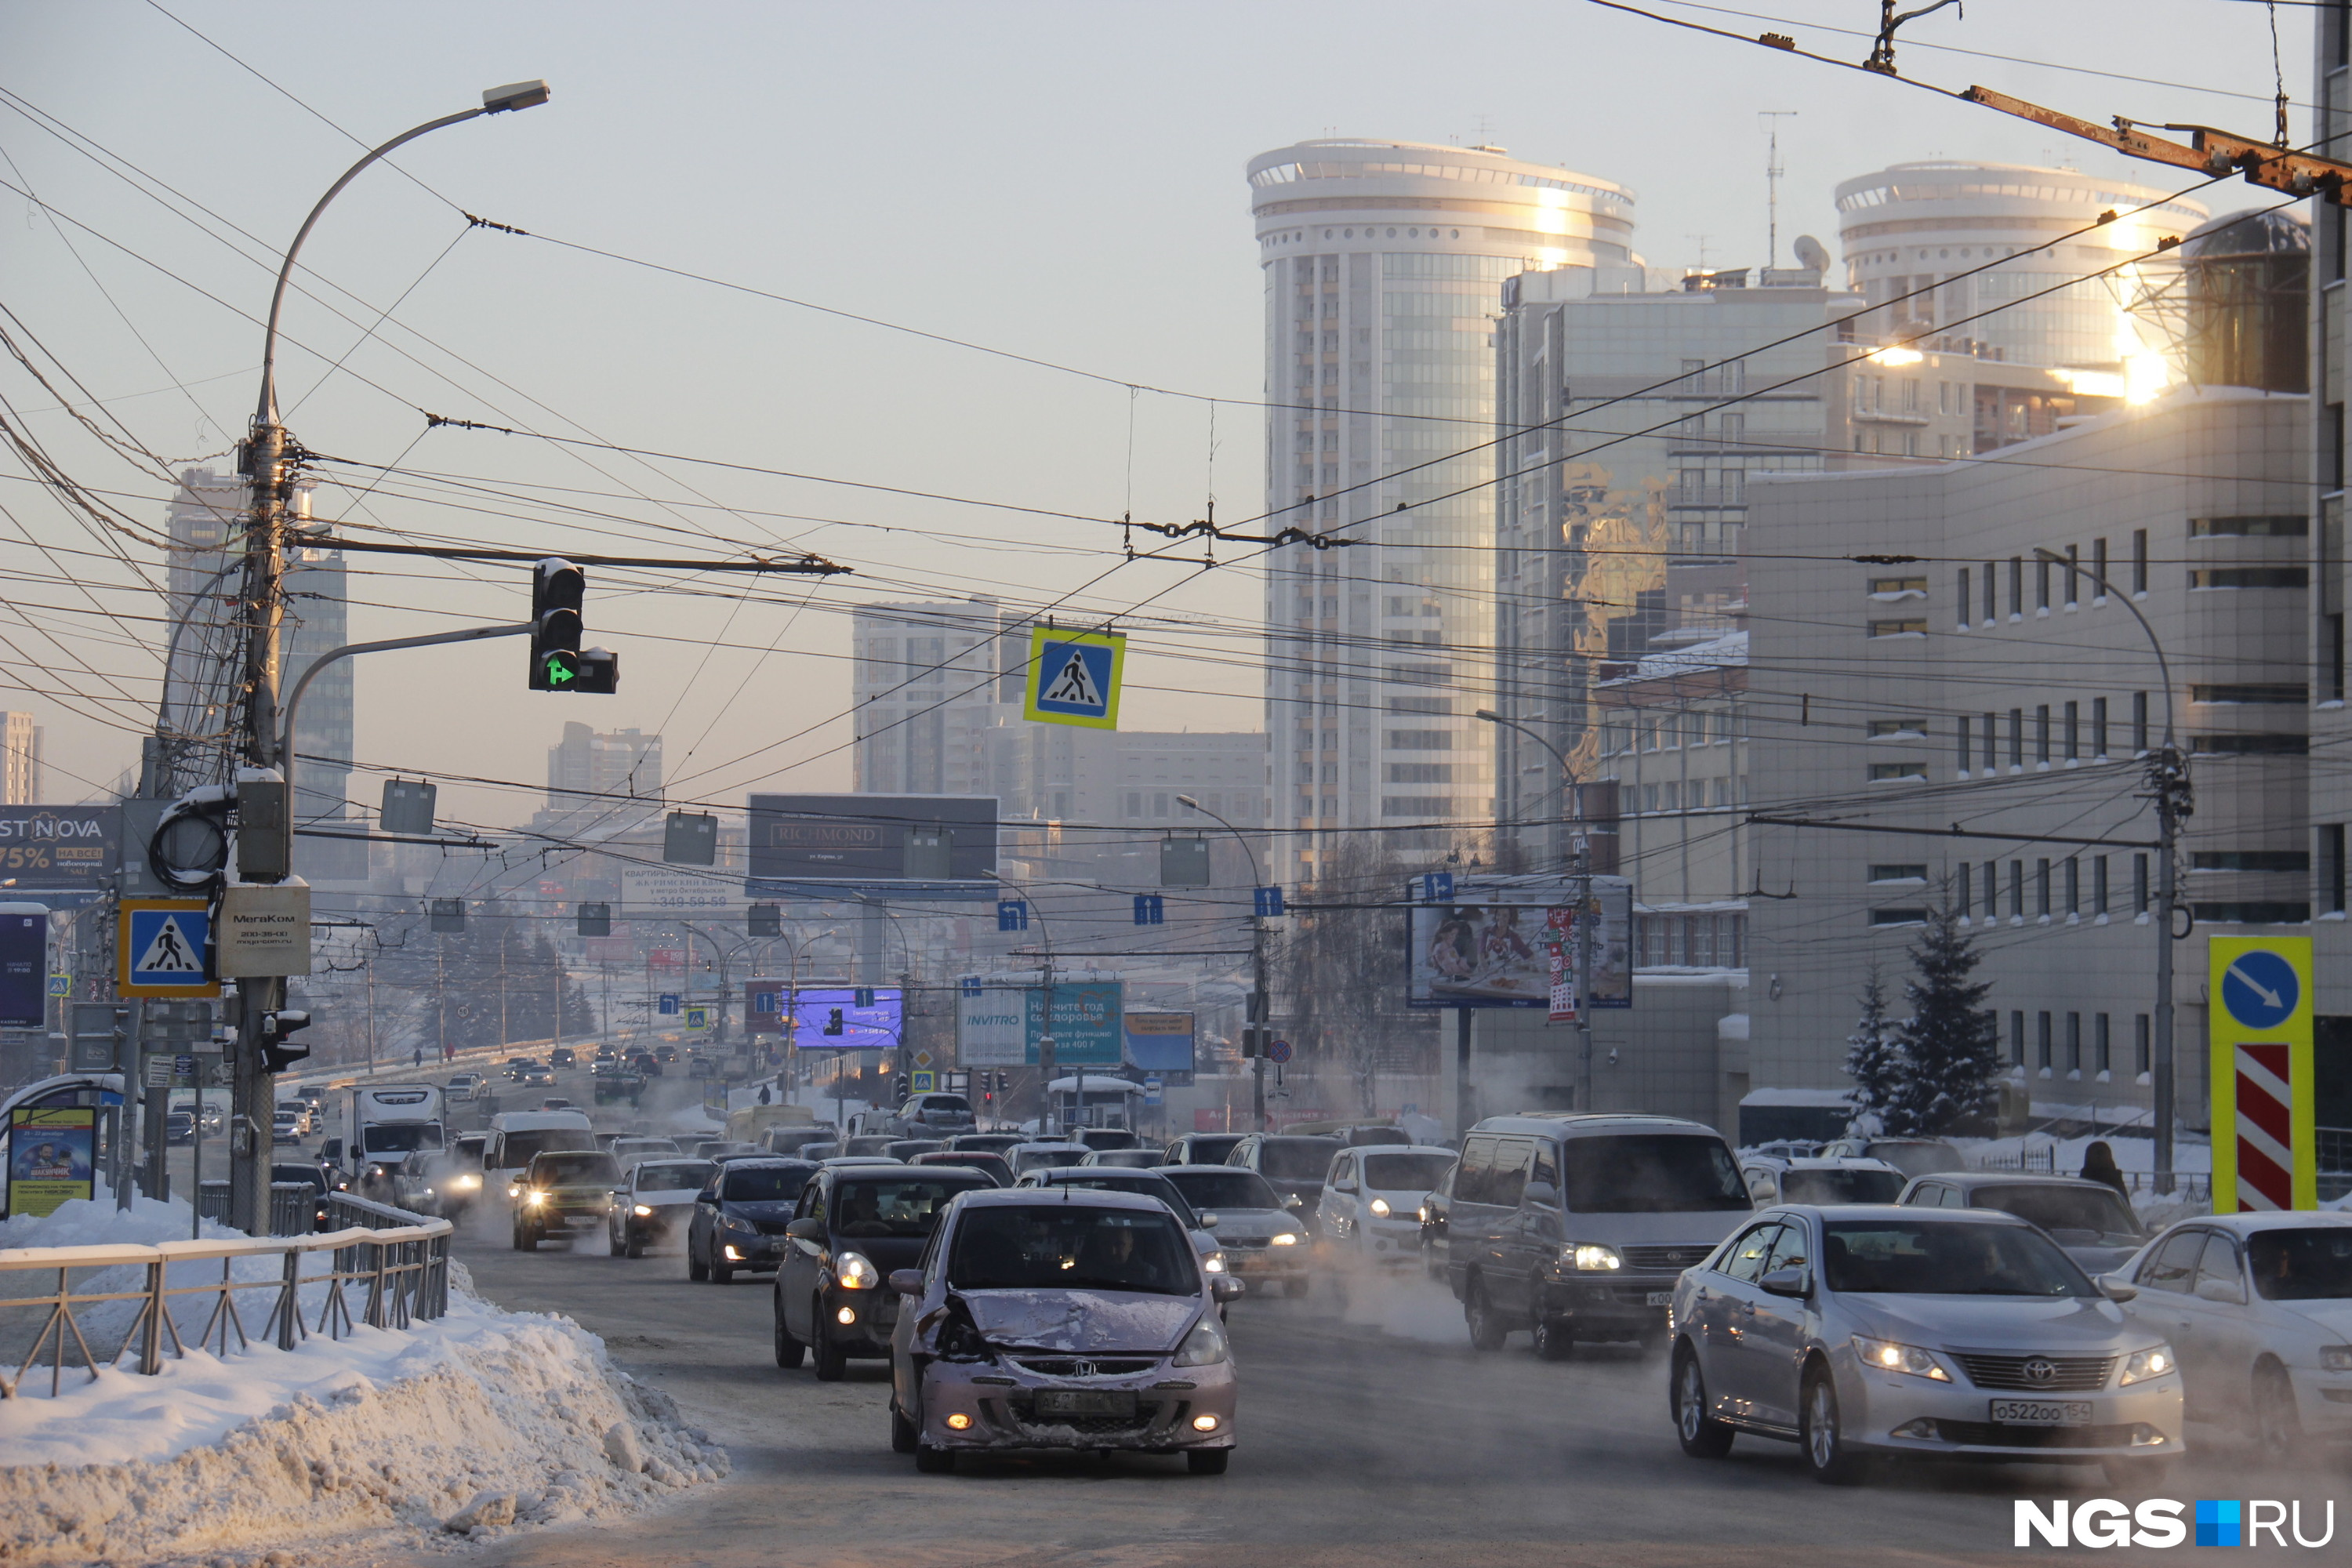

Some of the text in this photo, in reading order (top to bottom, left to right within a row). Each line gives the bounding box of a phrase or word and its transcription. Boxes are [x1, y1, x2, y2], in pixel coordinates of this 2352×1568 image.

[35, 820, 102, 837] NOVA
[779, 826, 875, 842] RICHMOND
[1084, 1003, 1104, 1012] год
[967, 1015, 1019, 1025] INVITRO
[2063, 1403, 2089, 1417] 154
